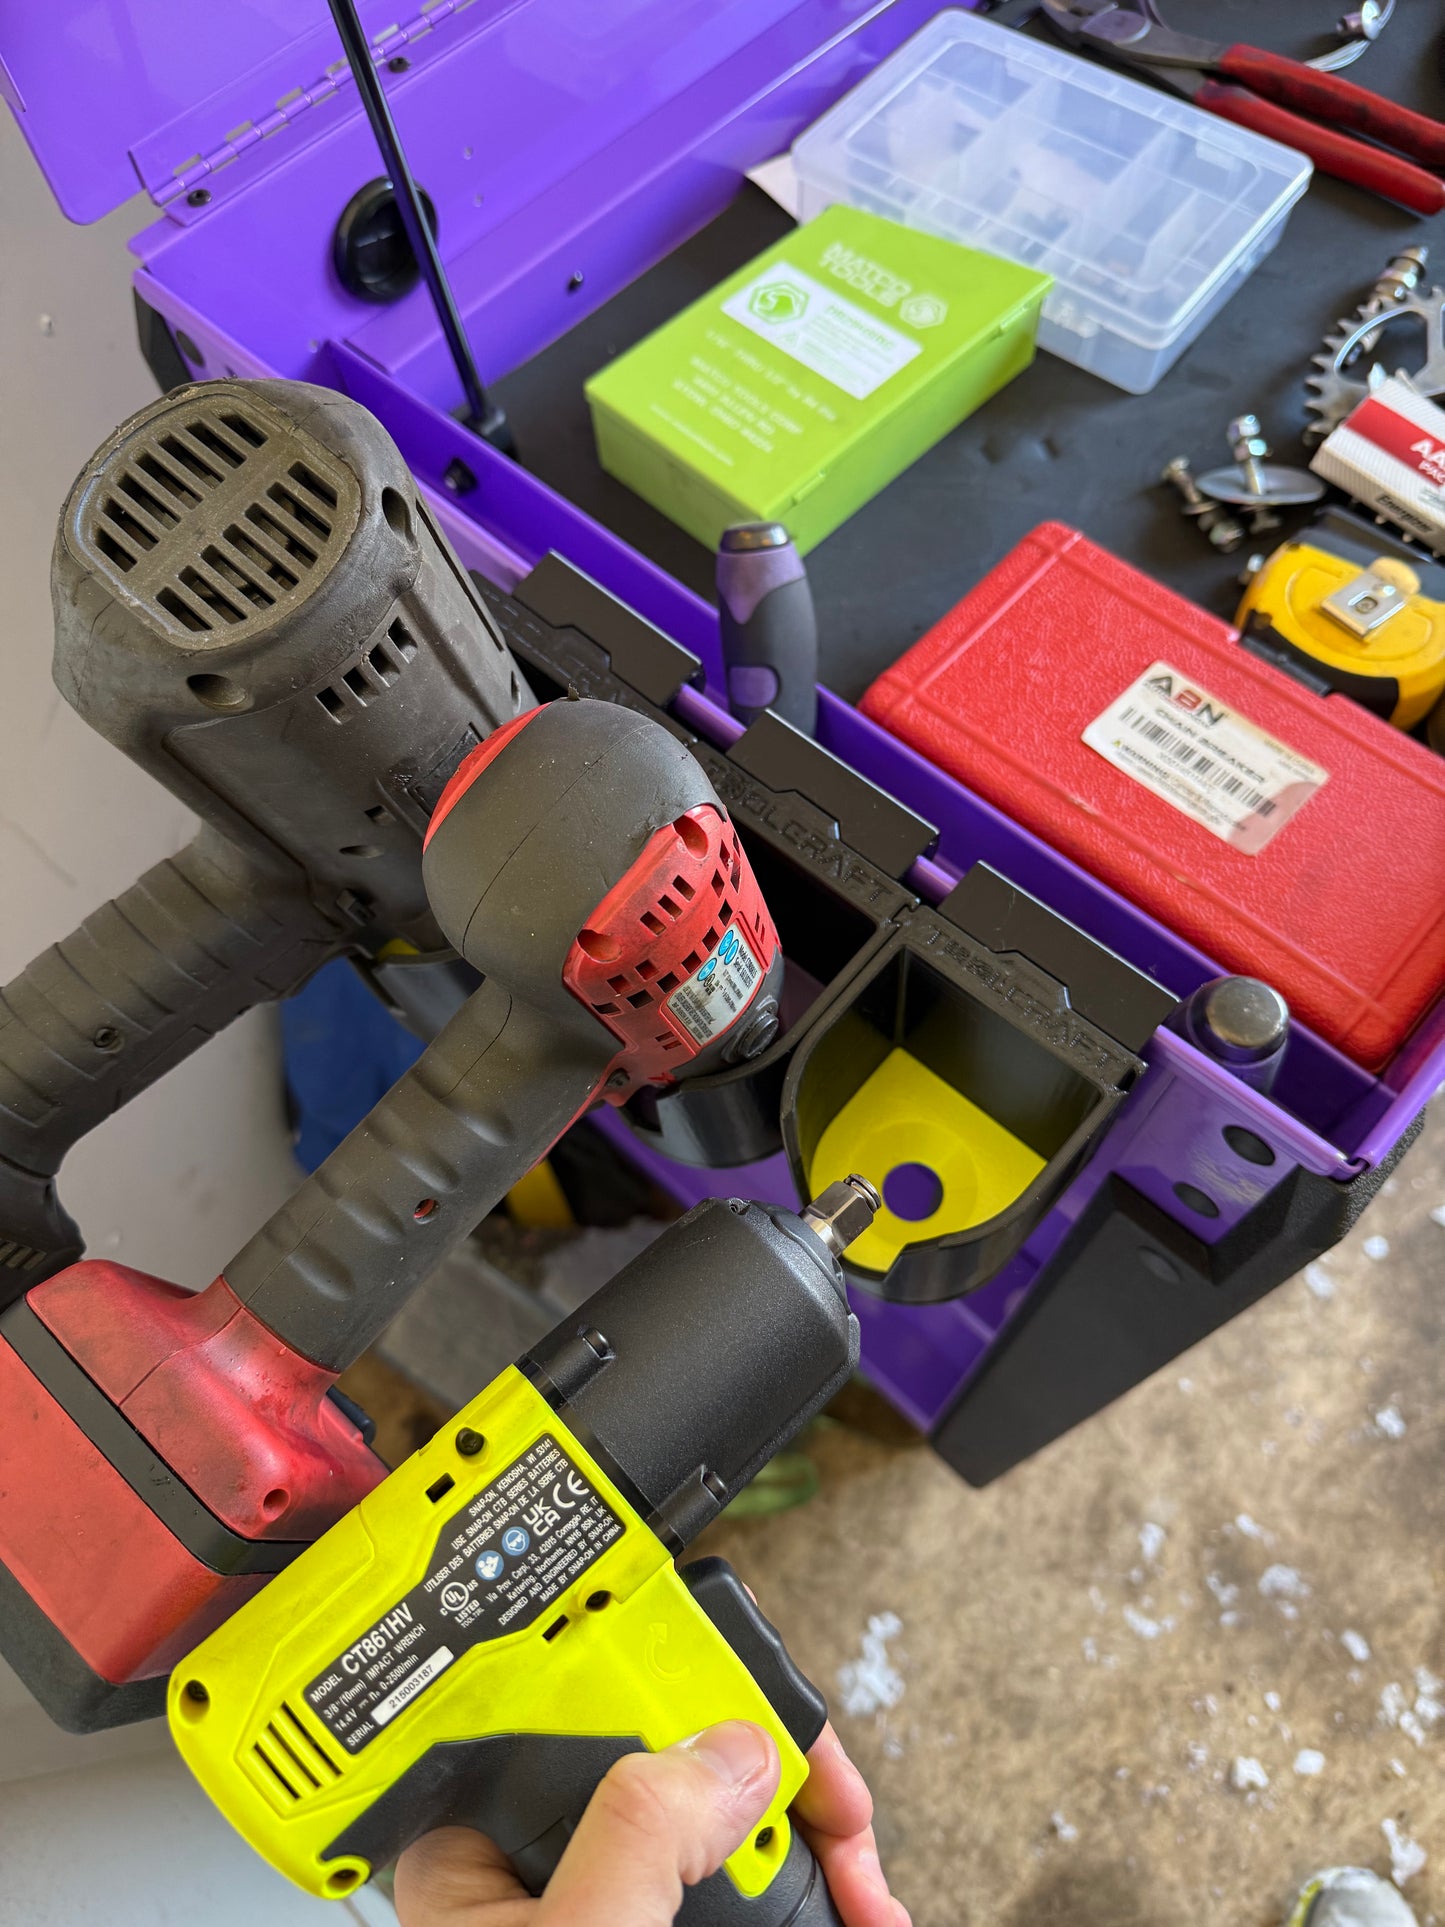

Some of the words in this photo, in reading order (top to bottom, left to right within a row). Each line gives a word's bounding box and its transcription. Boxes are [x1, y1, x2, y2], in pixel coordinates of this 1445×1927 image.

[823, 241, 912, 296] MATCO
[1149, 675, 1225, 726] ABN
[451, 1535, 467, 1551] USE
[465, 1510, 494, 1537] SNAP-ON
[492, 1499, 508, 1513] CTB
[506, 1479, 529, 1500] SERIES
[528, 1449, 561, 1481] BATTERIES
[469, 1492, 499, 1517] SNAP-ON,
[497, 1464, 529, 1492] KENOSHA,
[526, 1453, 537, 1464] WI
[536, 1438, 553, 1457] 53141
[424, 1567, 451, 1593] UTILISER
[449, 1555, 464, 1570] DES
[463, 1526, 495, 1557] BATTERIES
[493, 1502, 520, 1529] SNAP-ON
[518, 1497, 530, 1510] DE
[530, 1486, 540, 1497] LA
[538, 1470, 557, 1489] SERIE
[555, 1460, 569, 1473] CTB
[485, 1590, 498, 1602] Via
[496, 1578, 514, 1593] Prov.
[511, 1564, 530, 1579] Carpi,
[527, 1554, 541, 1565] 33,
[539, 1535, 557, 1555] 42015
[555, 1515, 582, 1539] Correggio
[579, 1504, 593, 1516] RE,
[590, 1495, 599, 1506] IT
[506, 1574, 537, 1601] Kettering,
[535, 1547, 567, 1574] Northants,
[564, 1529, 582, 1546] NN16
[580, 1516, 597, 1532] 8SN,
[595, 1507, 607, 1518] UK
[539, 1585, 559, 1602] MADE
[557, 1574, 568, 1585] BY
[568, 1549, 595, 1575] SNAP-ON
[594, 1541, 603, 1551] IN
[602, 1525, 622, 1542] CHINA
[467, 1579, 479, 1591] US
[498, 1597, 529, 1626] DESIGNED
[529, 1584, 543, 1597] AND
[542, 1549, 578, 1583] ENGINEERED
[579, 1540, 588, 1551] BY
[588, 1516, 615, 1541] SNAP-ON
[455, 1600, 480, 1623] LISTED
[461, 1615, 475, 1629] TOOL
[310, 1673, 343, 1703] MODEL
[341, 1602, 414, 1675] CT861HV
[365, 1652, 395, 1680] IMPACT
[393, 1623, 427, 1654] WRENCH
[334, 1709, 359, 1731] 14.4V
[346, 1721, 375, 1746] SERIAL
[388, 1664, 434, 1709] 215003187
